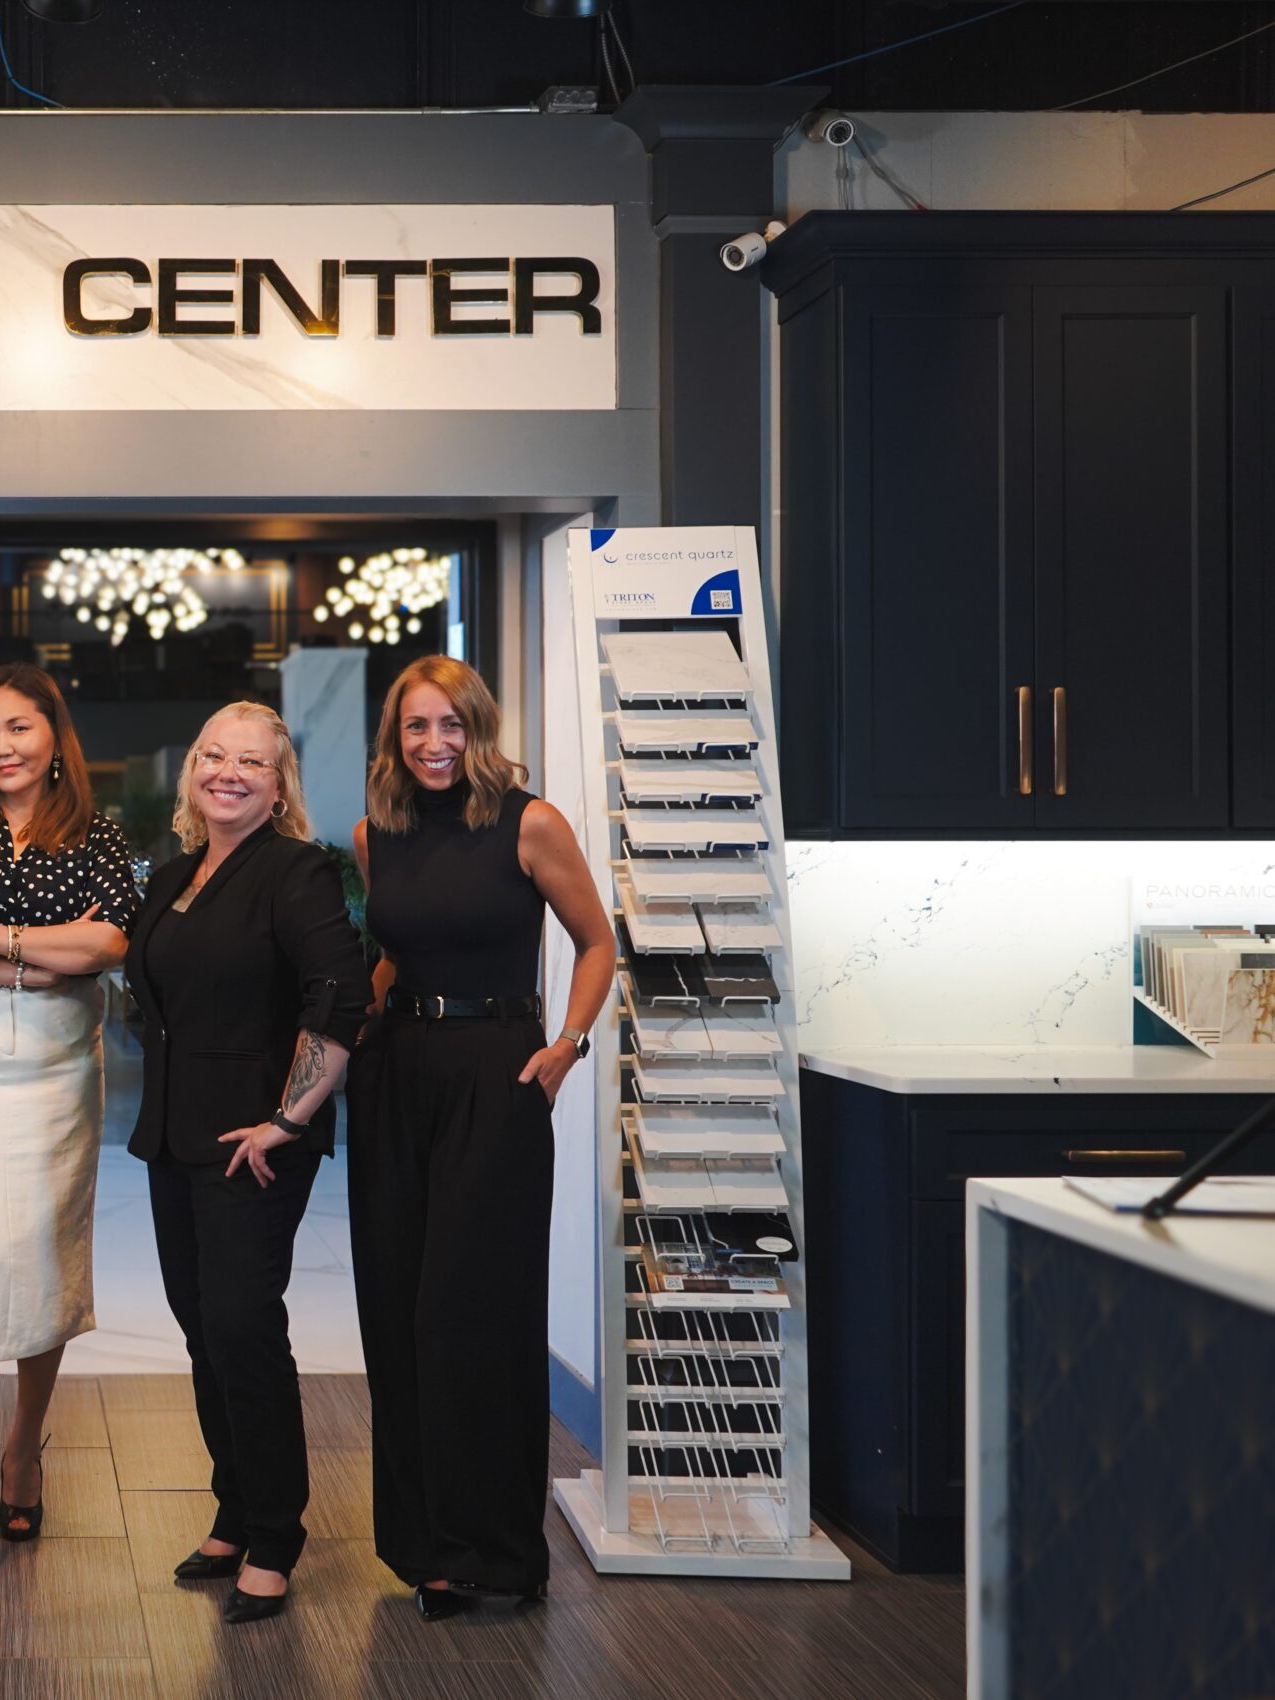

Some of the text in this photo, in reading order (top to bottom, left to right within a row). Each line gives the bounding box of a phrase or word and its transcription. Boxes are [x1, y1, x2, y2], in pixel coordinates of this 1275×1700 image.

[63, 257, 602, 337] CENTER
[625, 550, 734, 561] crescent quartz
[612, 593, 655, 602] TRITON
